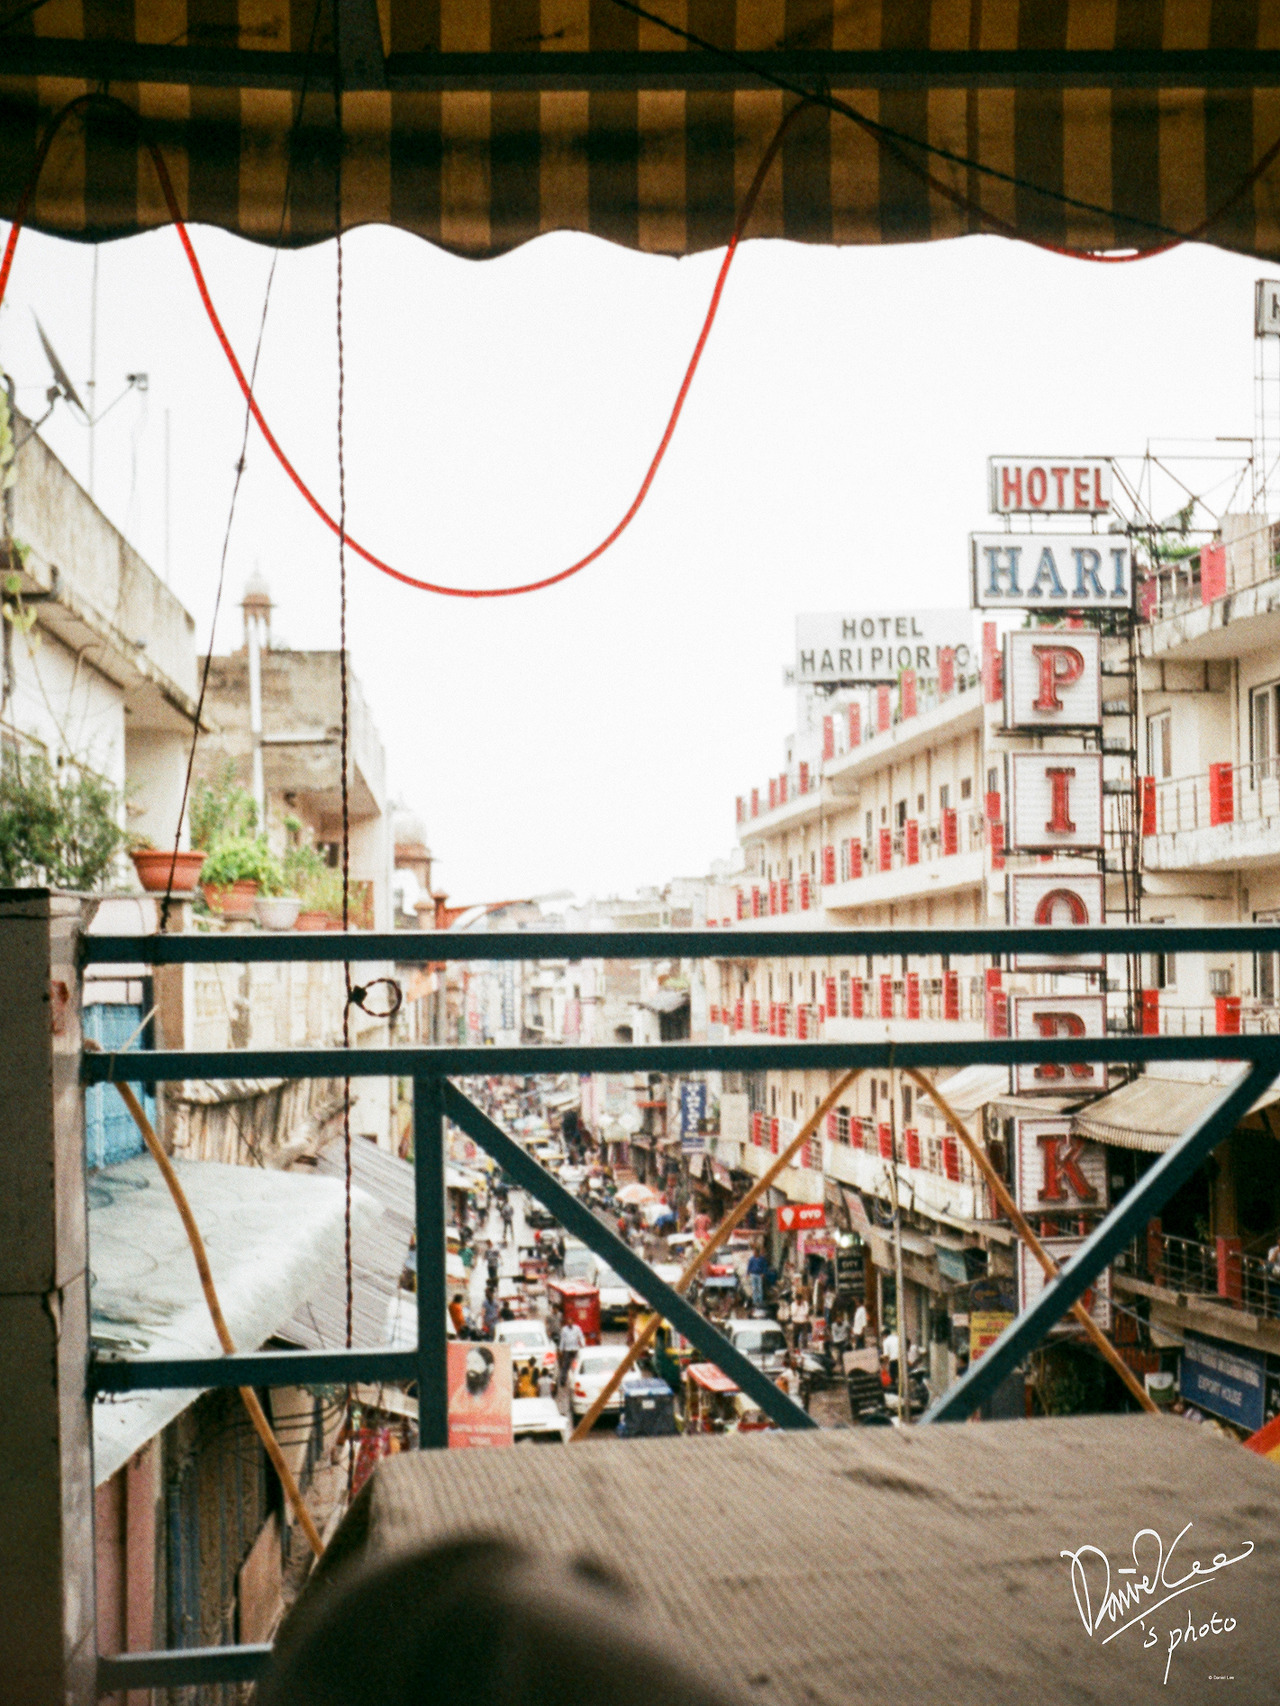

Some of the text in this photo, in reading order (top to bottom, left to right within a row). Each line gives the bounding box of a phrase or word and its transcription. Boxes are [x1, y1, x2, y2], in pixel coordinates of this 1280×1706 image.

[1002, 466, 1110, 509] HOTEL
[983, 546, 1128, 599] HARI
[842, 616, 923, 640] HOTEL
[801, 648, 863, 674] HARI
